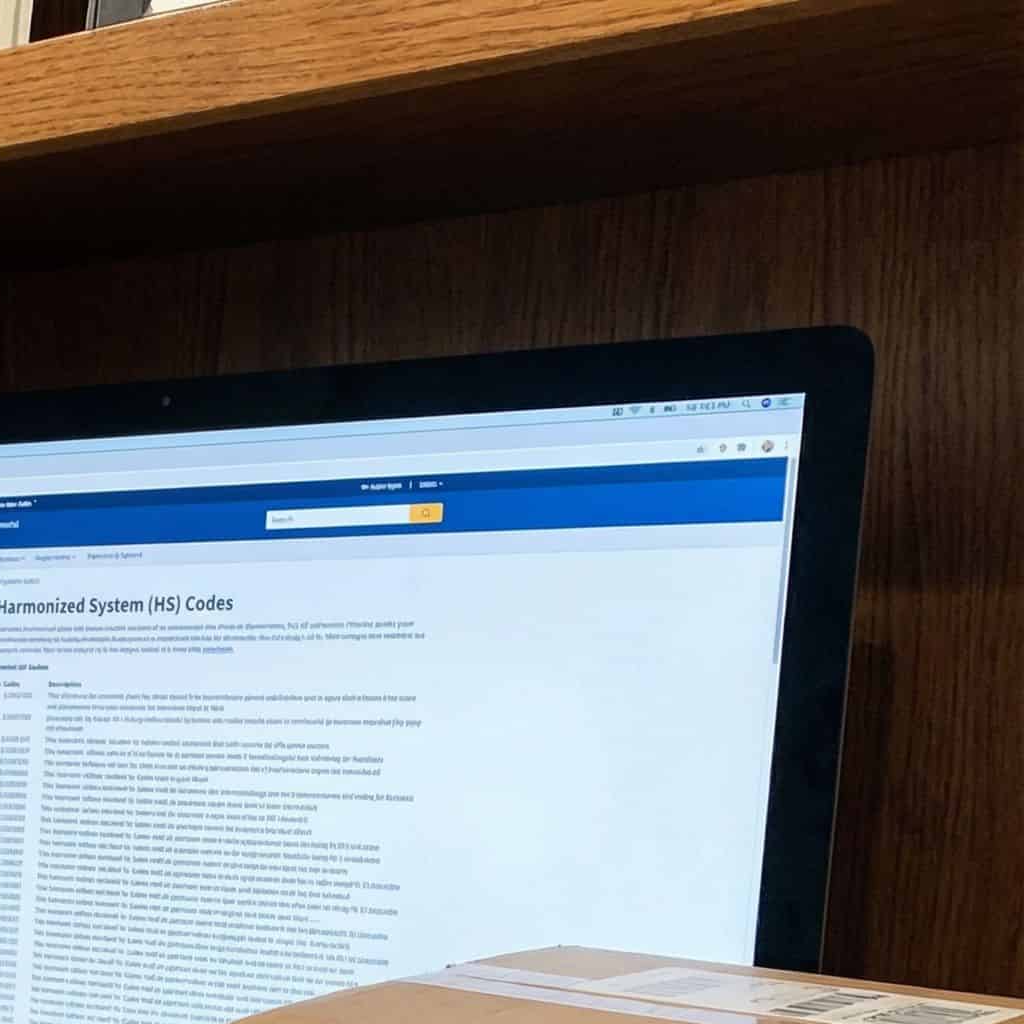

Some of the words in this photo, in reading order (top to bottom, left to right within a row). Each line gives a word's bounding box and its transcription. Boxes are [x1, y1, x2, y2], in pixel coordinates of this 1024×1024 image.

[89, 596, 143, 616] System
[148, 594, 181, 616] (HS)
[185, 594, 233, 612] Codes
